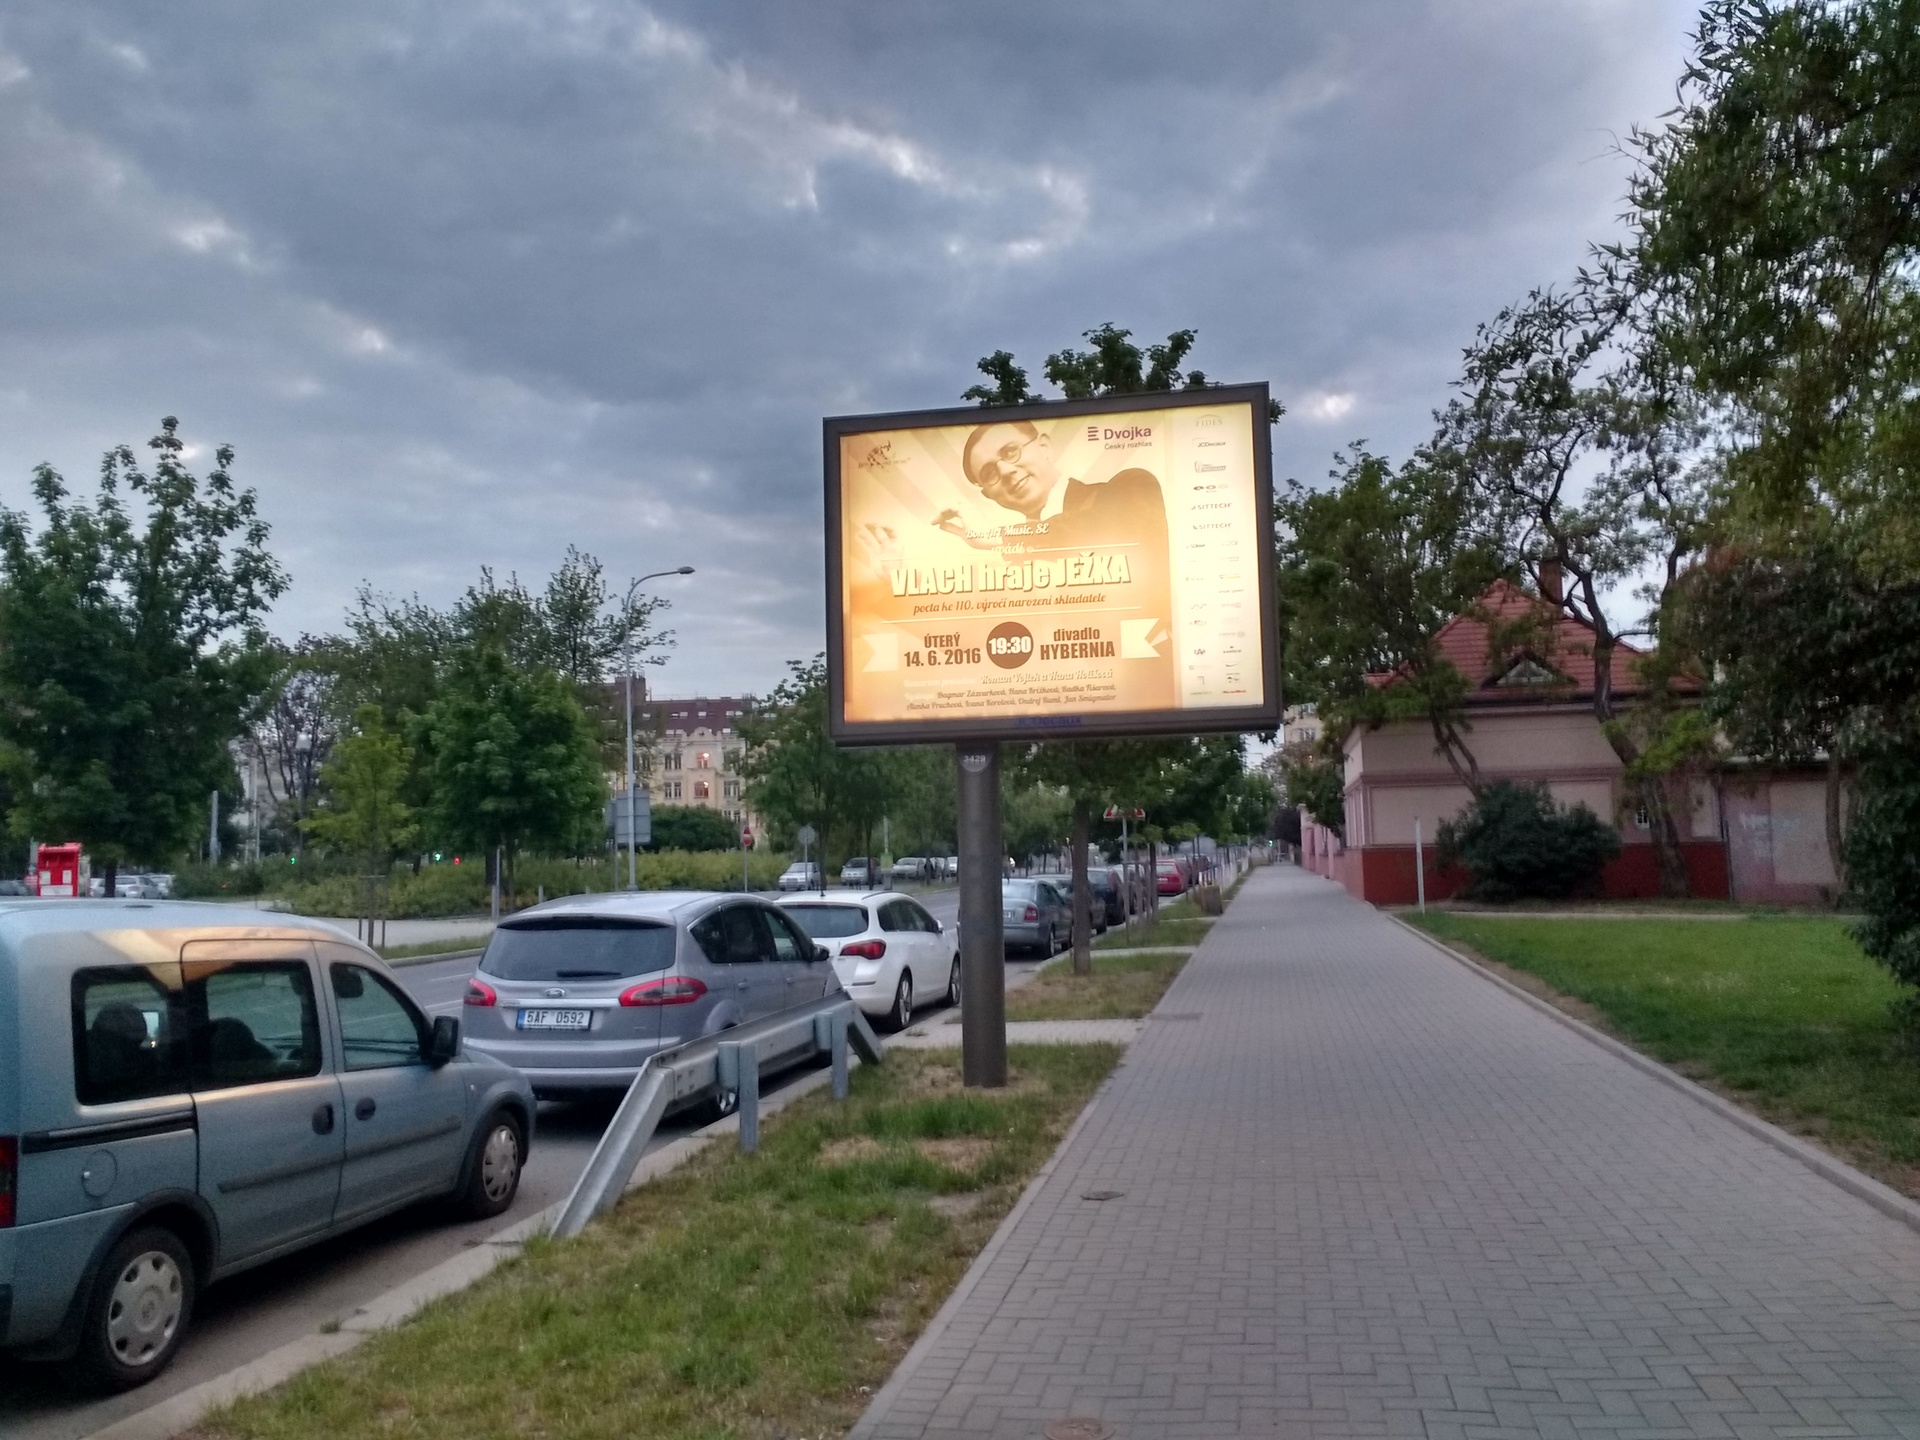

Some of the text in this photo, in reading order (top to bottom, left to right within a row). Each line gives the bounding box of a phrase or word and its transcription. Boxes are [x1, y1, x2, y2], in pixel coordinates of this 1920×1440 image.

[1104, 426, 1152, 441] Dvojka
[1104, 442, 1126, 450] Český
[1035, 523, 1050, 535] SE
[890, 552, 1132, 597] VLACH hraje JEŽKA
[913, 593, 1107, 616] pocta ke 110. výročí narození skladatele
[924, 632, 961, 649] ÚTERÝ
[1053, 627, 1100, 642] divadlo
[988, 635, 1032, 655] 19:30
[1040, 641, 1116, 660] HYBERNIA
[904, 647, 982, 667] 14. 6. 2016
[526, 1011, 585, 1024] 5AF 0592
